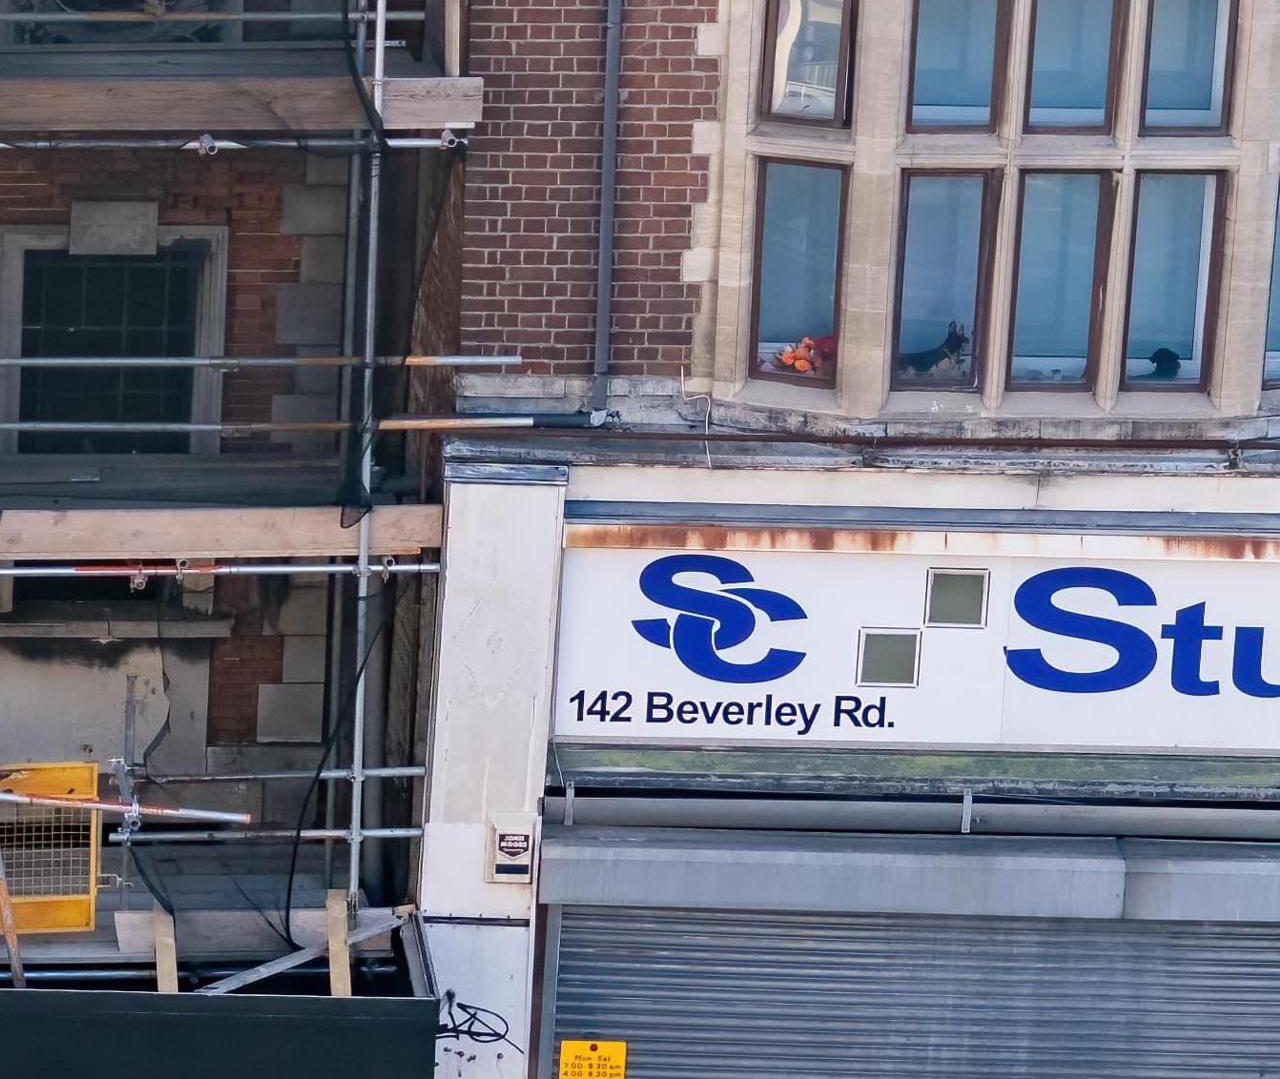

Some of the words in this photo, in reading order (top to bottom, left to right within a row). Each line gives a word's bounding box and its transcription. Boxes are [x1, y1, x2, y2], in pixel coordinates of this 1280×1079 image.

[569, 690, 632, 723] 142
[646, 691, 821, 735] Beverley
[834, 696, 895, 728] Rd.
